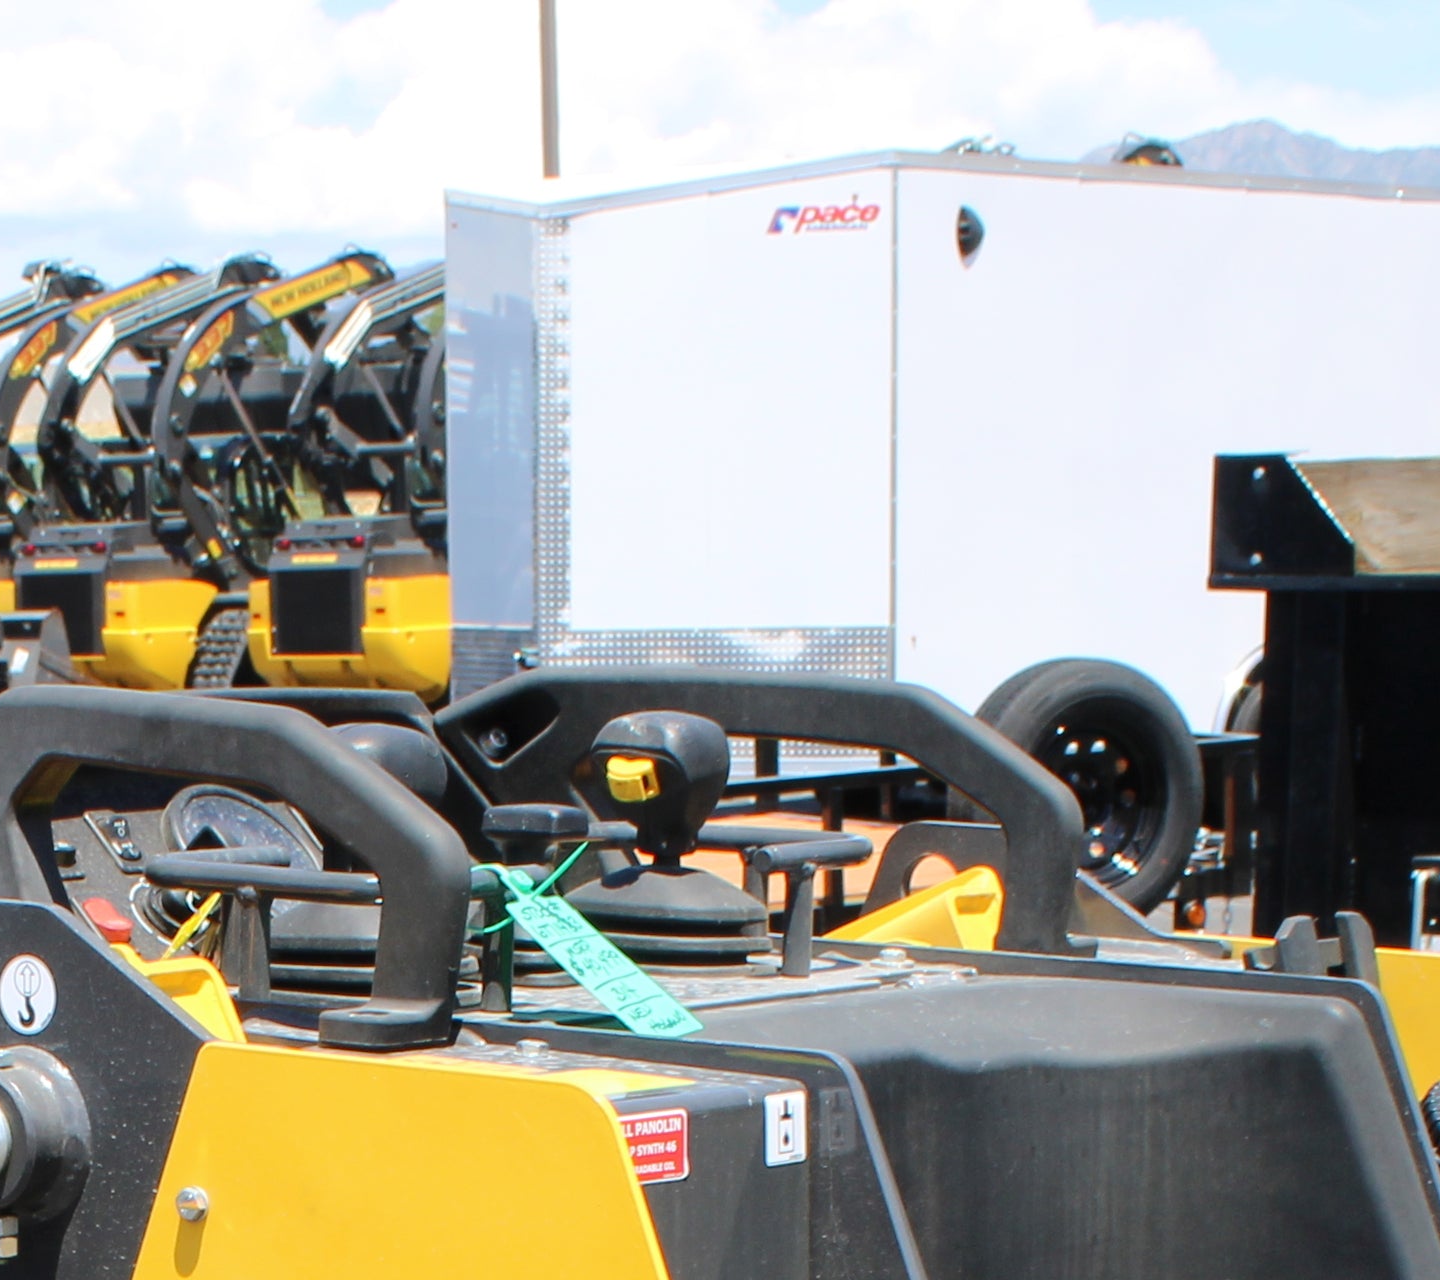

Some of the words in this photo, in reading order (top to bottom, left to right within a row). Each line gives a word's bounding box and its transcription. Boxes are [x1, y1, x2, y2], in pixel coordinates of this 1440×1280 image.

[635, 1117, 682, 1136] PANOLIN
[636, 1141, 665, 1157] SYNTH
[665, 1140, 677, 1153] 46
